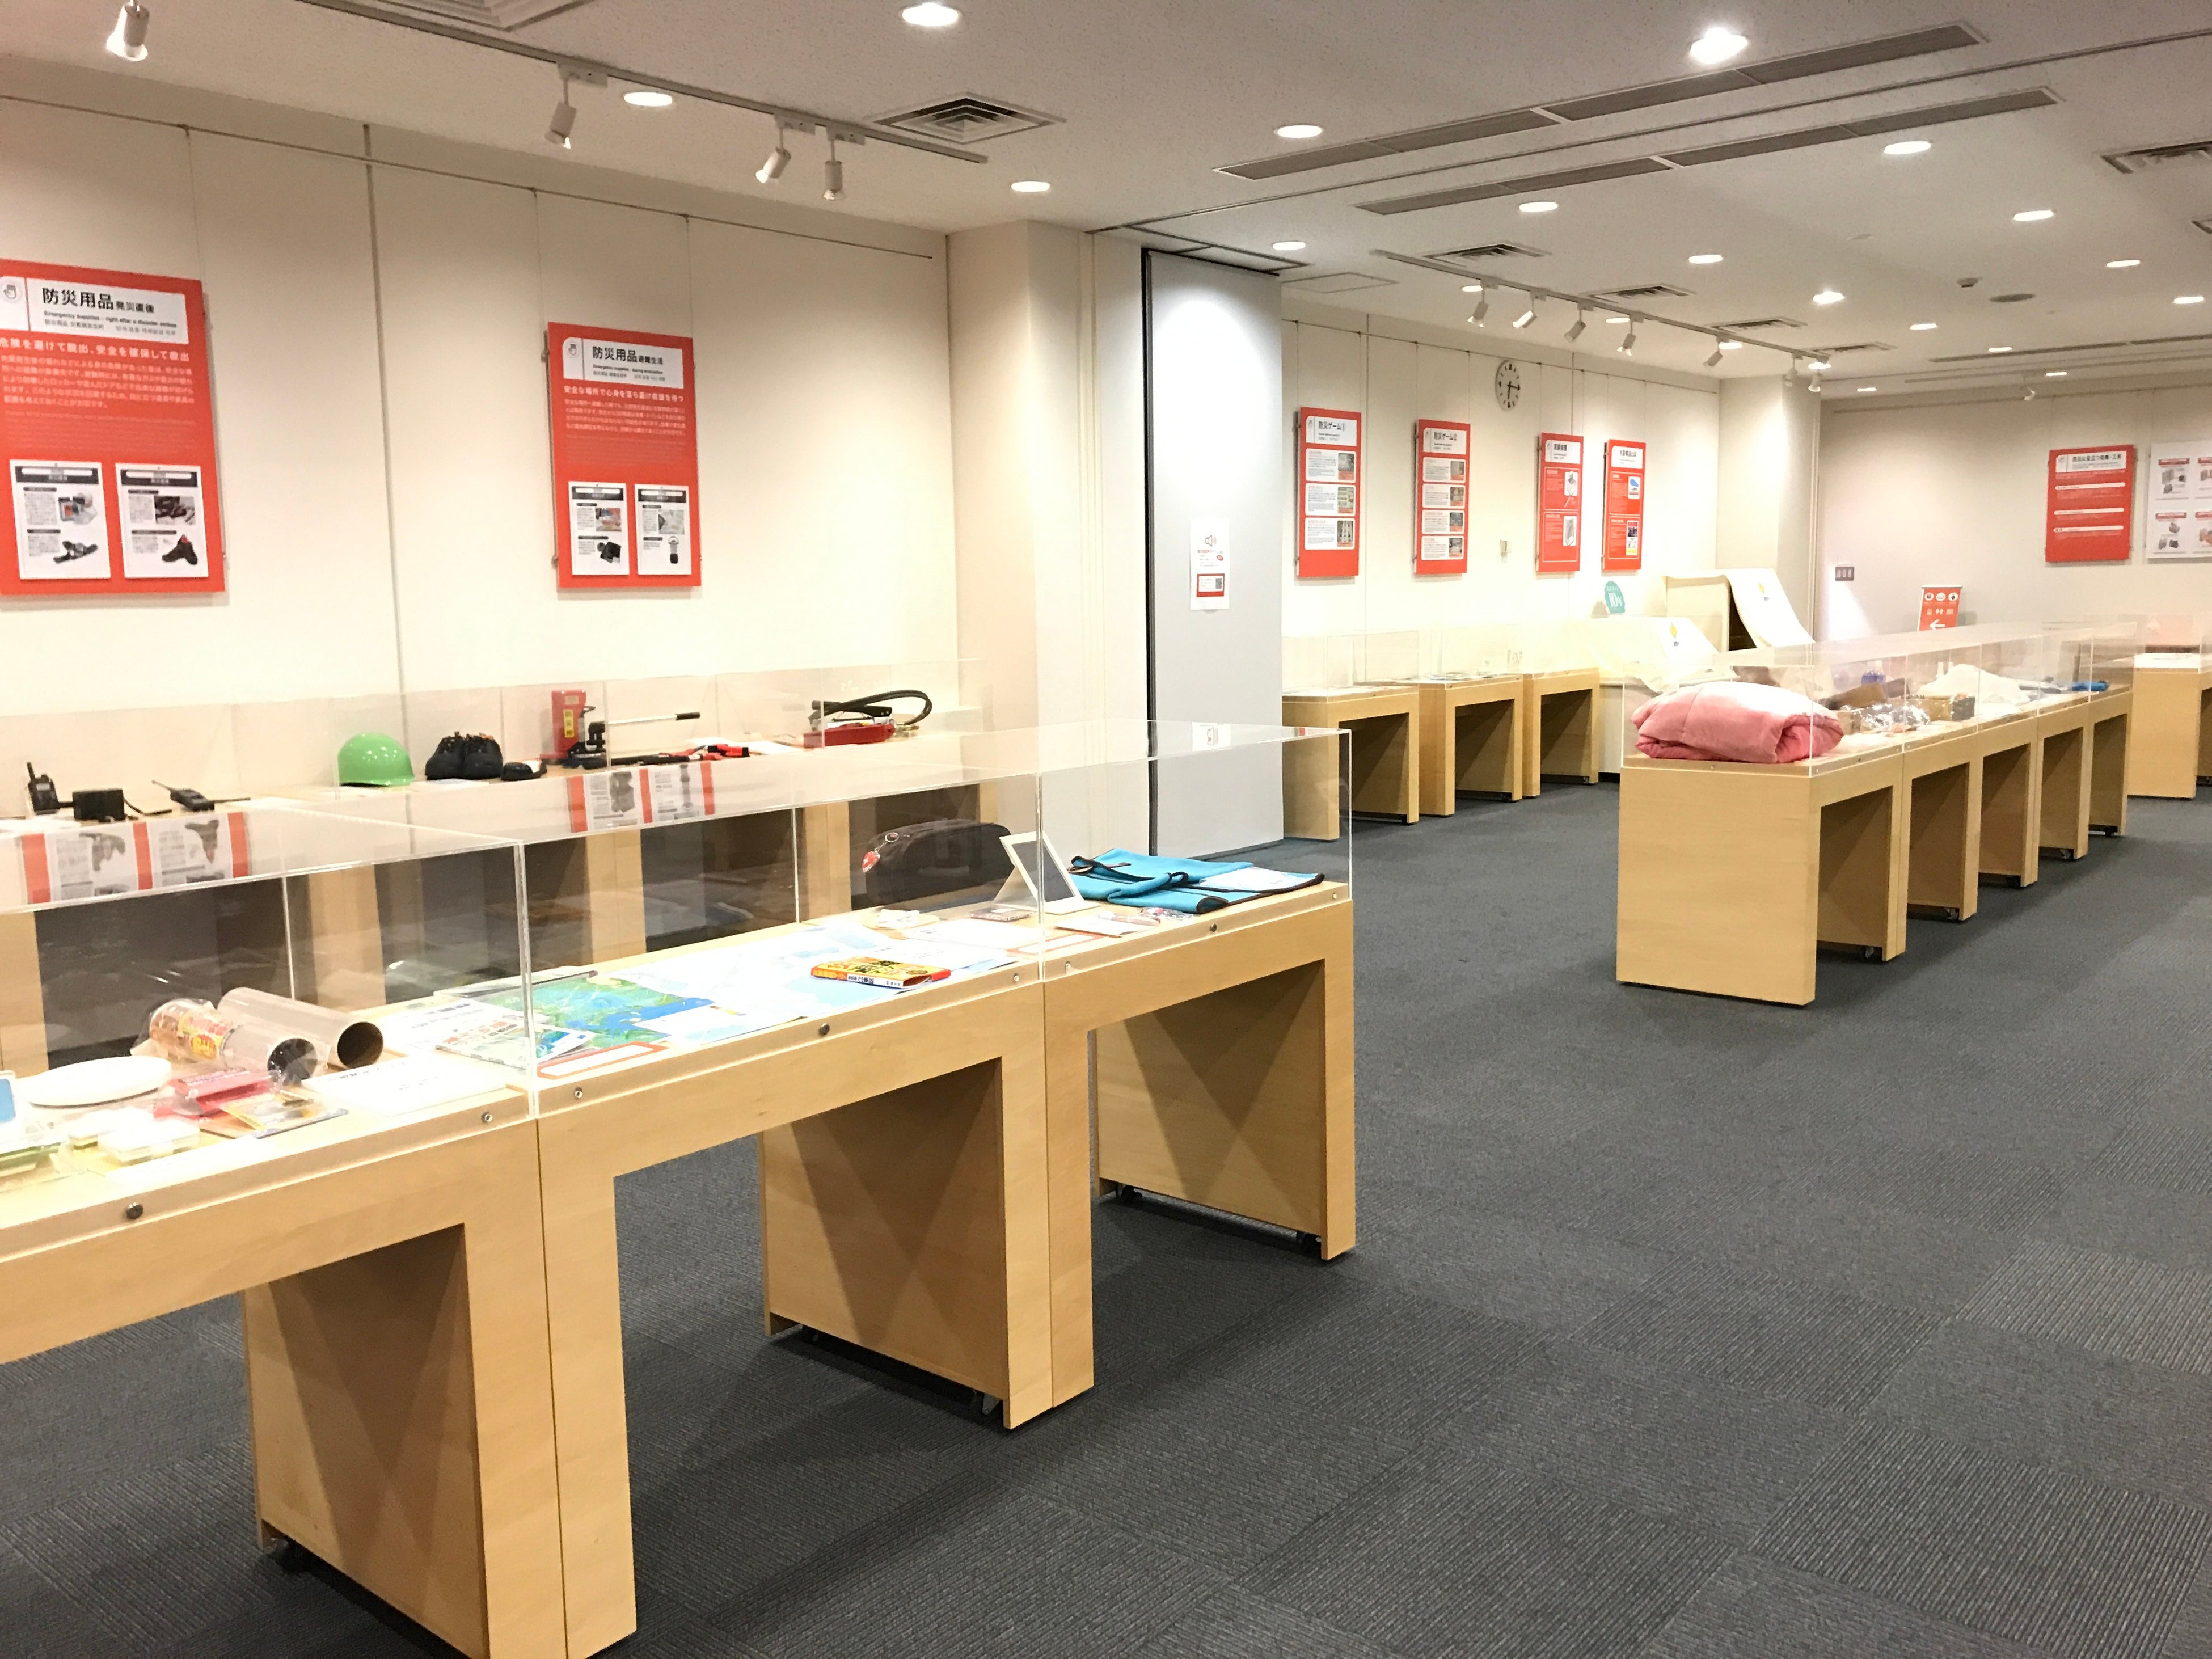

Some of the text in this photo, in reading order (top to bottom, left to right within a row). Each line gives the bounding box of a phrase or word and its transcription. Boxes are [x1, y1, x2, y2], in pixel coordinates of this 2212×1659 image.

[42, 287, 114, 310] 防災用品
[592, 346, 663, 365] 防災用品 避難生活
